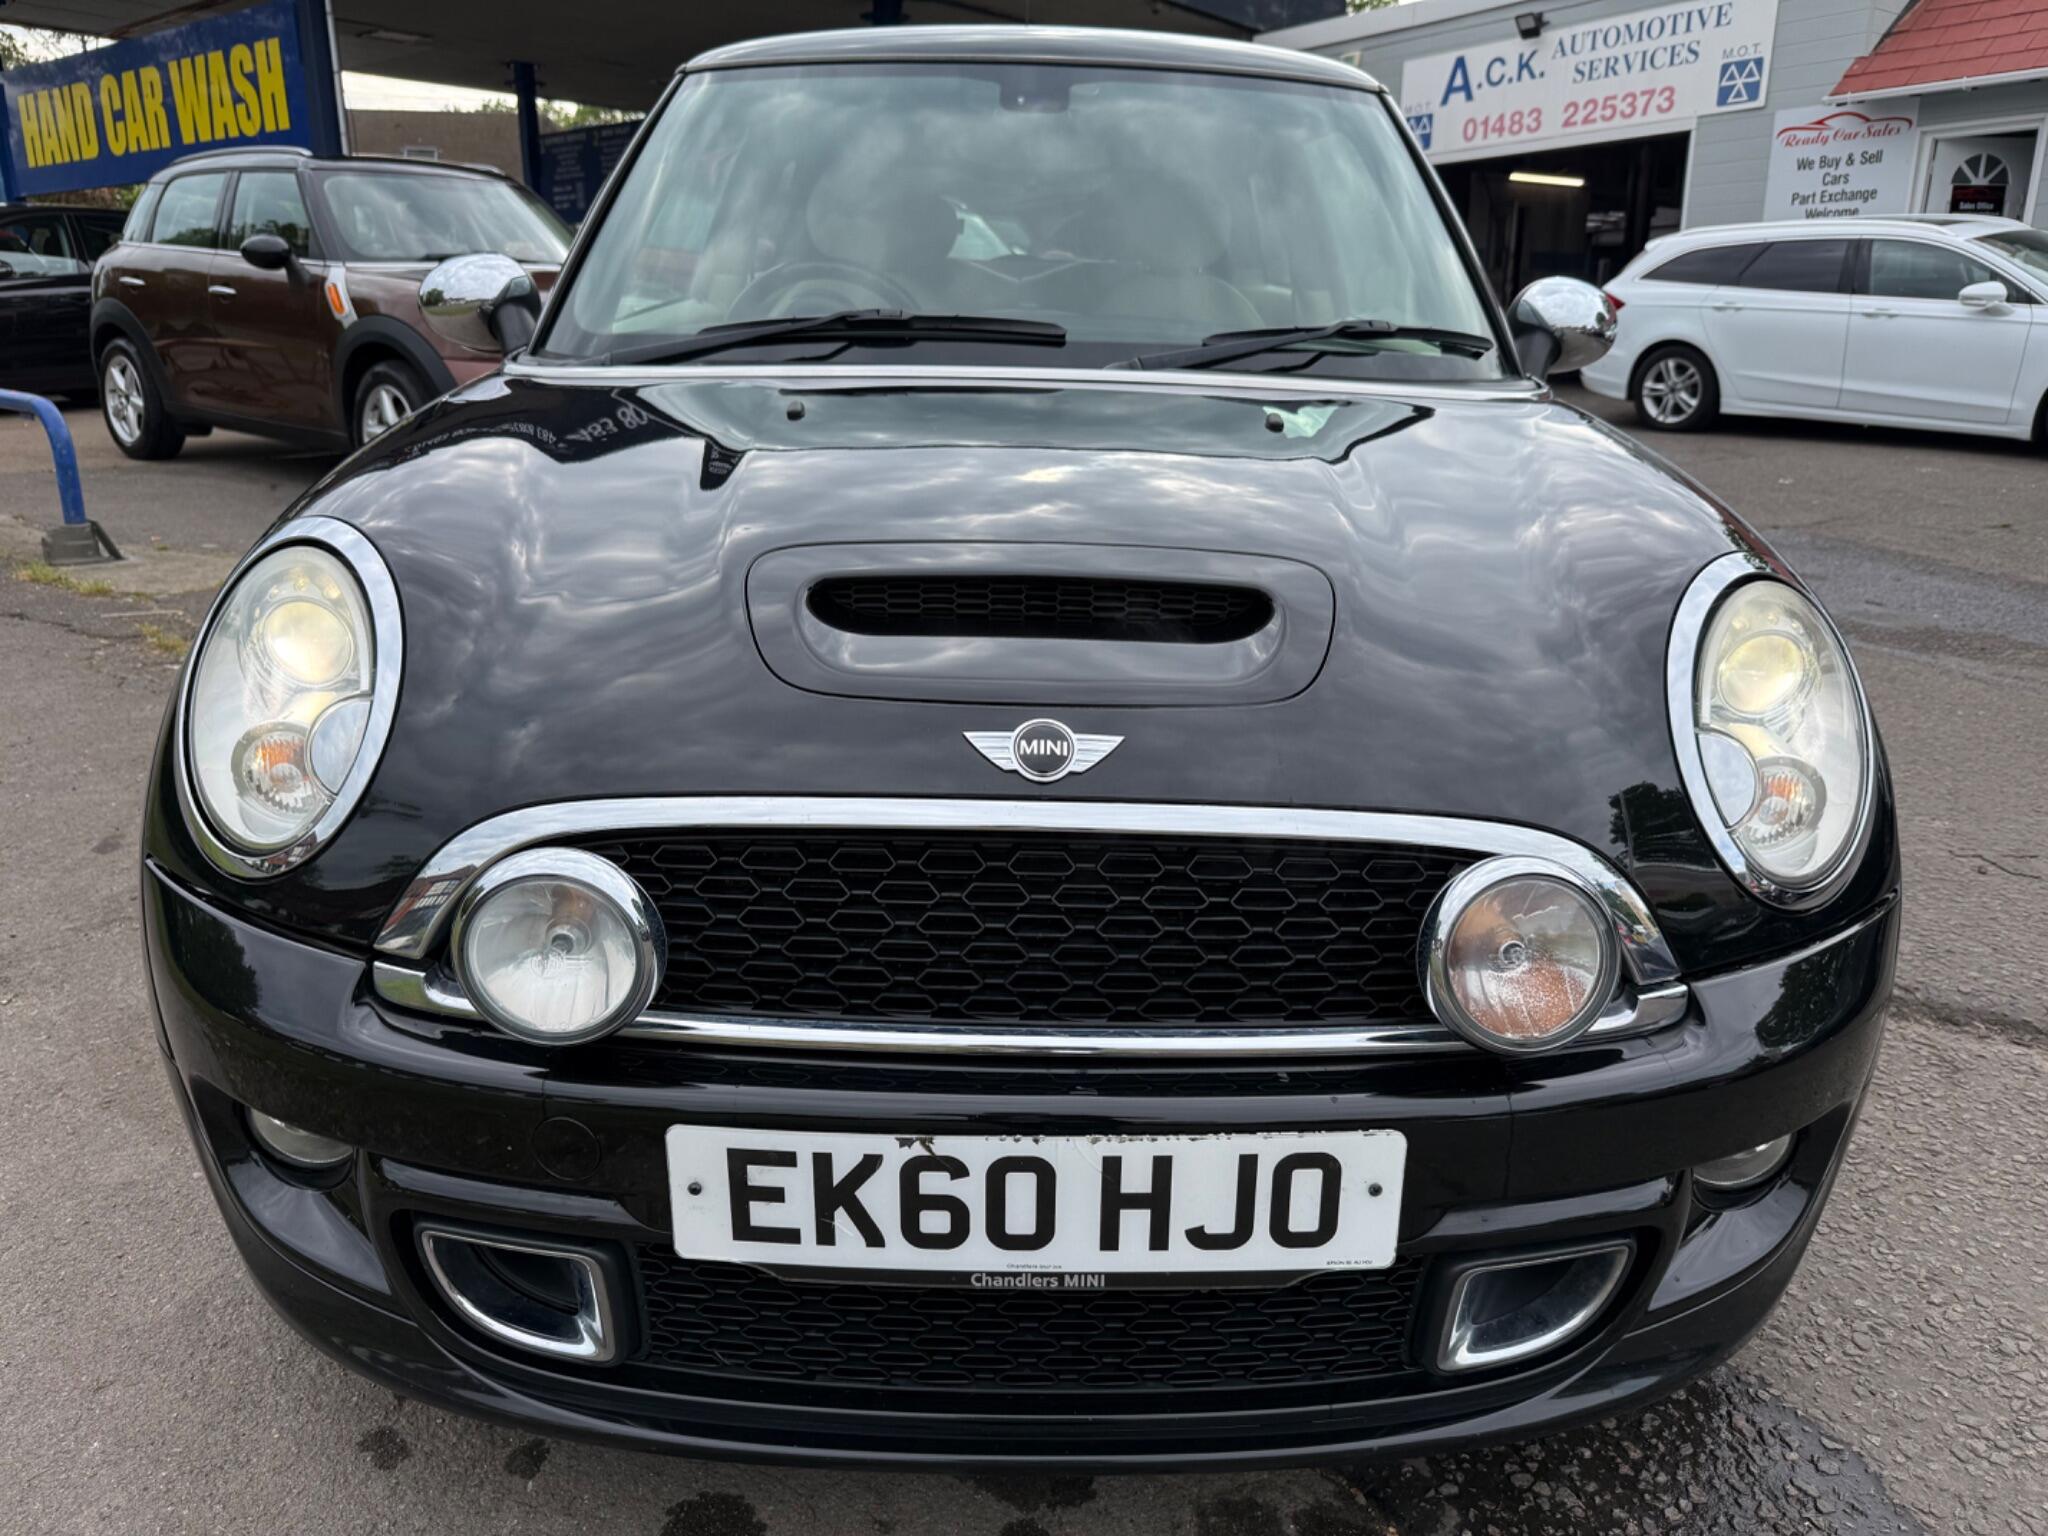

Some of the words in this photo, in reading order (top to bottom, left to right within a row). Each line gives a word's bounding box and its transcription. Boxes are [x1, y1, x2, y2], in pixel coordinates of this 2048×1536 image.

[1552, 2, 1733, 60] AUTOMOTIVE
[1572, 40, 1700, 84] SERVICES
[18, 82, 99, 168] HAND
[100, 66, 171, 156] CAR
[167, 37, 290, 145] WASH
[1462, 107, 1542, 142] 01483
[1561, 86, 1676, 128] 225373
[1784, 132, 1829, 147] Ready
[1832, 128, 1859, 141] Car
[1861, 122, 1900, 138] Sales
[1797, 157, 1814, 170] We
[1819, 154, 1841, 170] Buy
[1845, 152, 1855, 166] &
[1860, 149, 1883, 165] Sell
[1822, 172, 1849, 186] Cars
[1791, 191, 1816, 205] Part
[1820, 188, 1877, 203] Exchange
[1019, 739, 1068, 757] MINI
[726, 1147, 1057, 1251] EK60
[1099, 1152, 1343, 1251] HJO
[970, 1273, 1059, 1287] Chandlers
[1064, 1274, 1105, 1287] MINI
